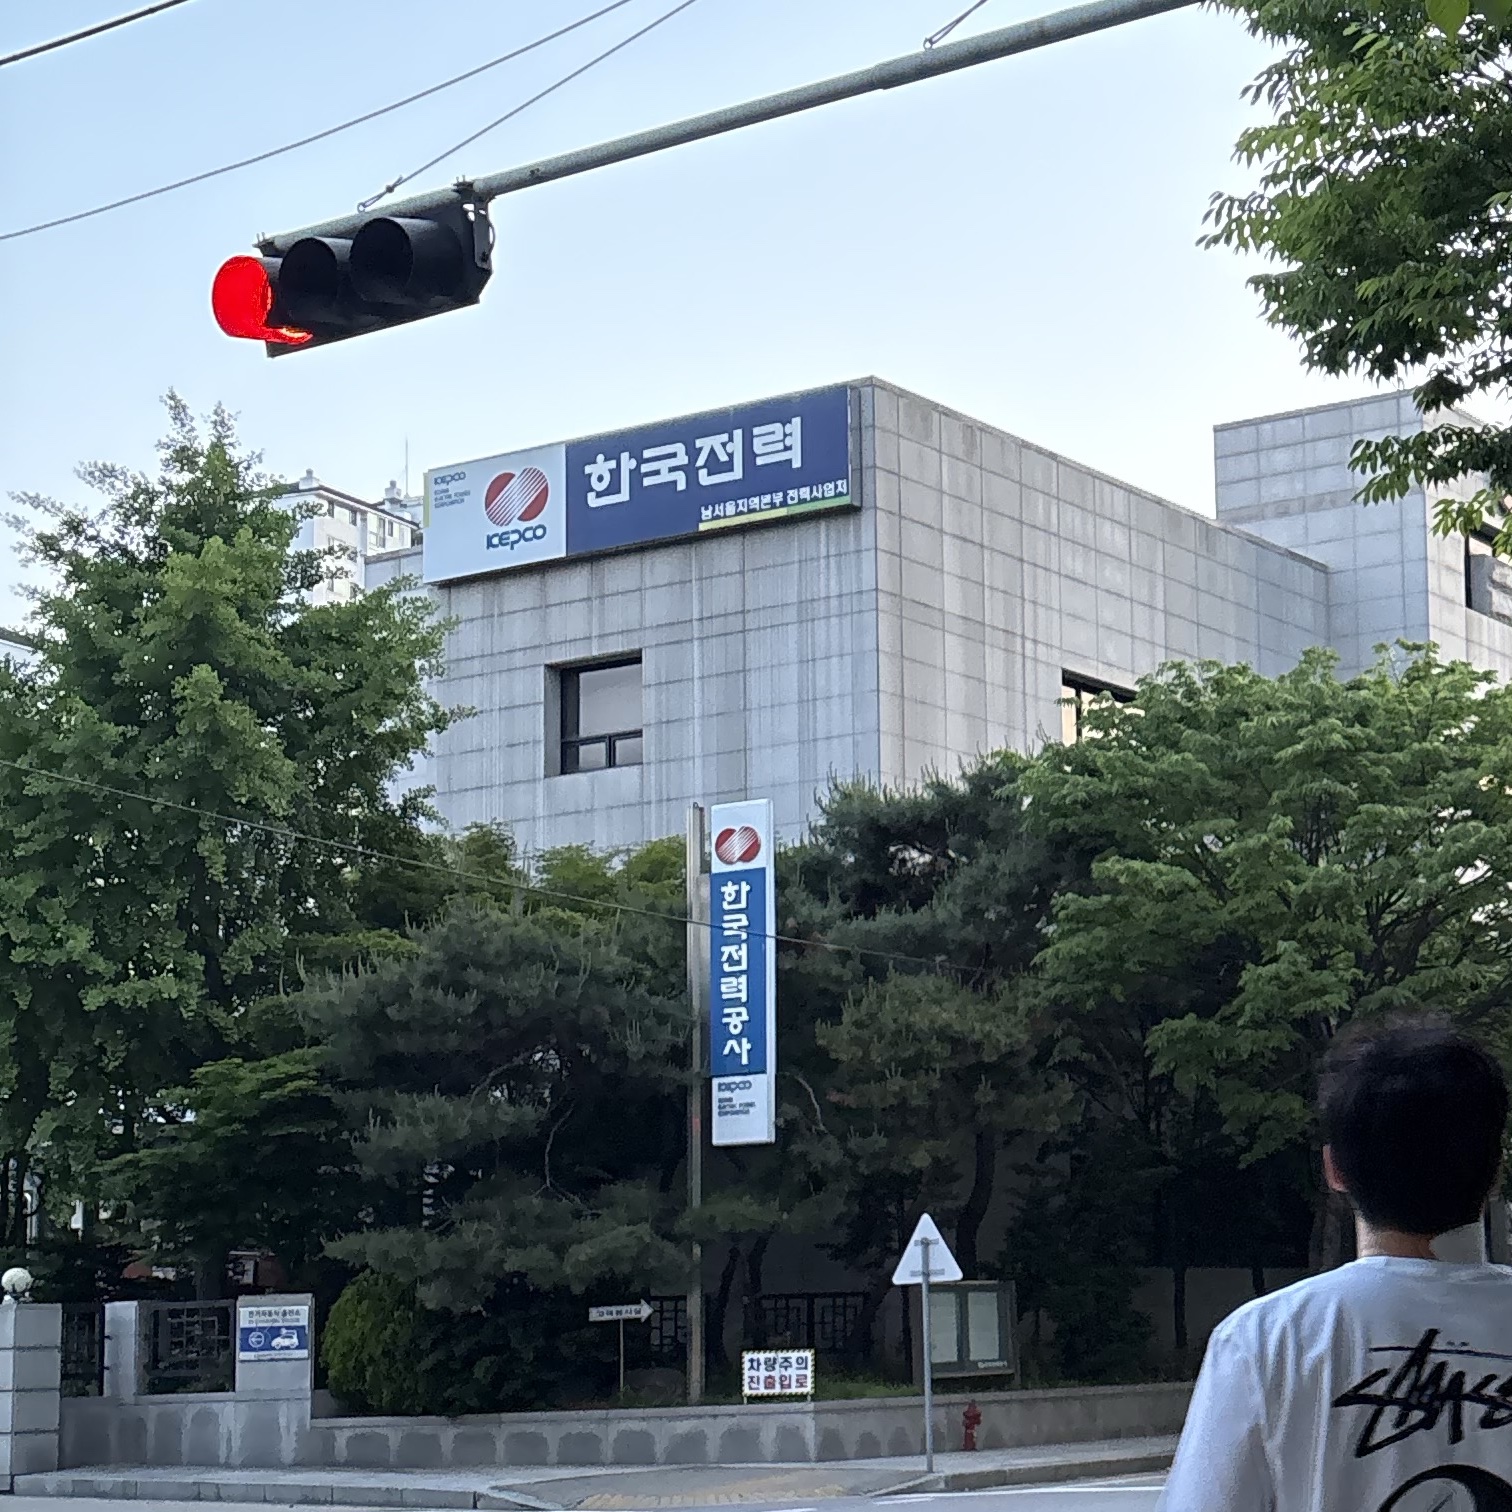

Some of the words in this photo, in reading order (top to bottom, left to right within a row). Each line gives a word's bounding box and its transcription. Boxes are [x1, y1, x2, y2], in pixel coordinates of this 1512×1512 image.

[584, 416, 803, 508] 한국전력
[700, 491, 784, 521] 남서울지역본부
[486, 524, 548, 551] KEPCO
[720, 880, 752, 1067] 한국전력공사
[747, 1355, 809, 1373] 차량주의
[747, 1373, 809, 1391] 진출입로
